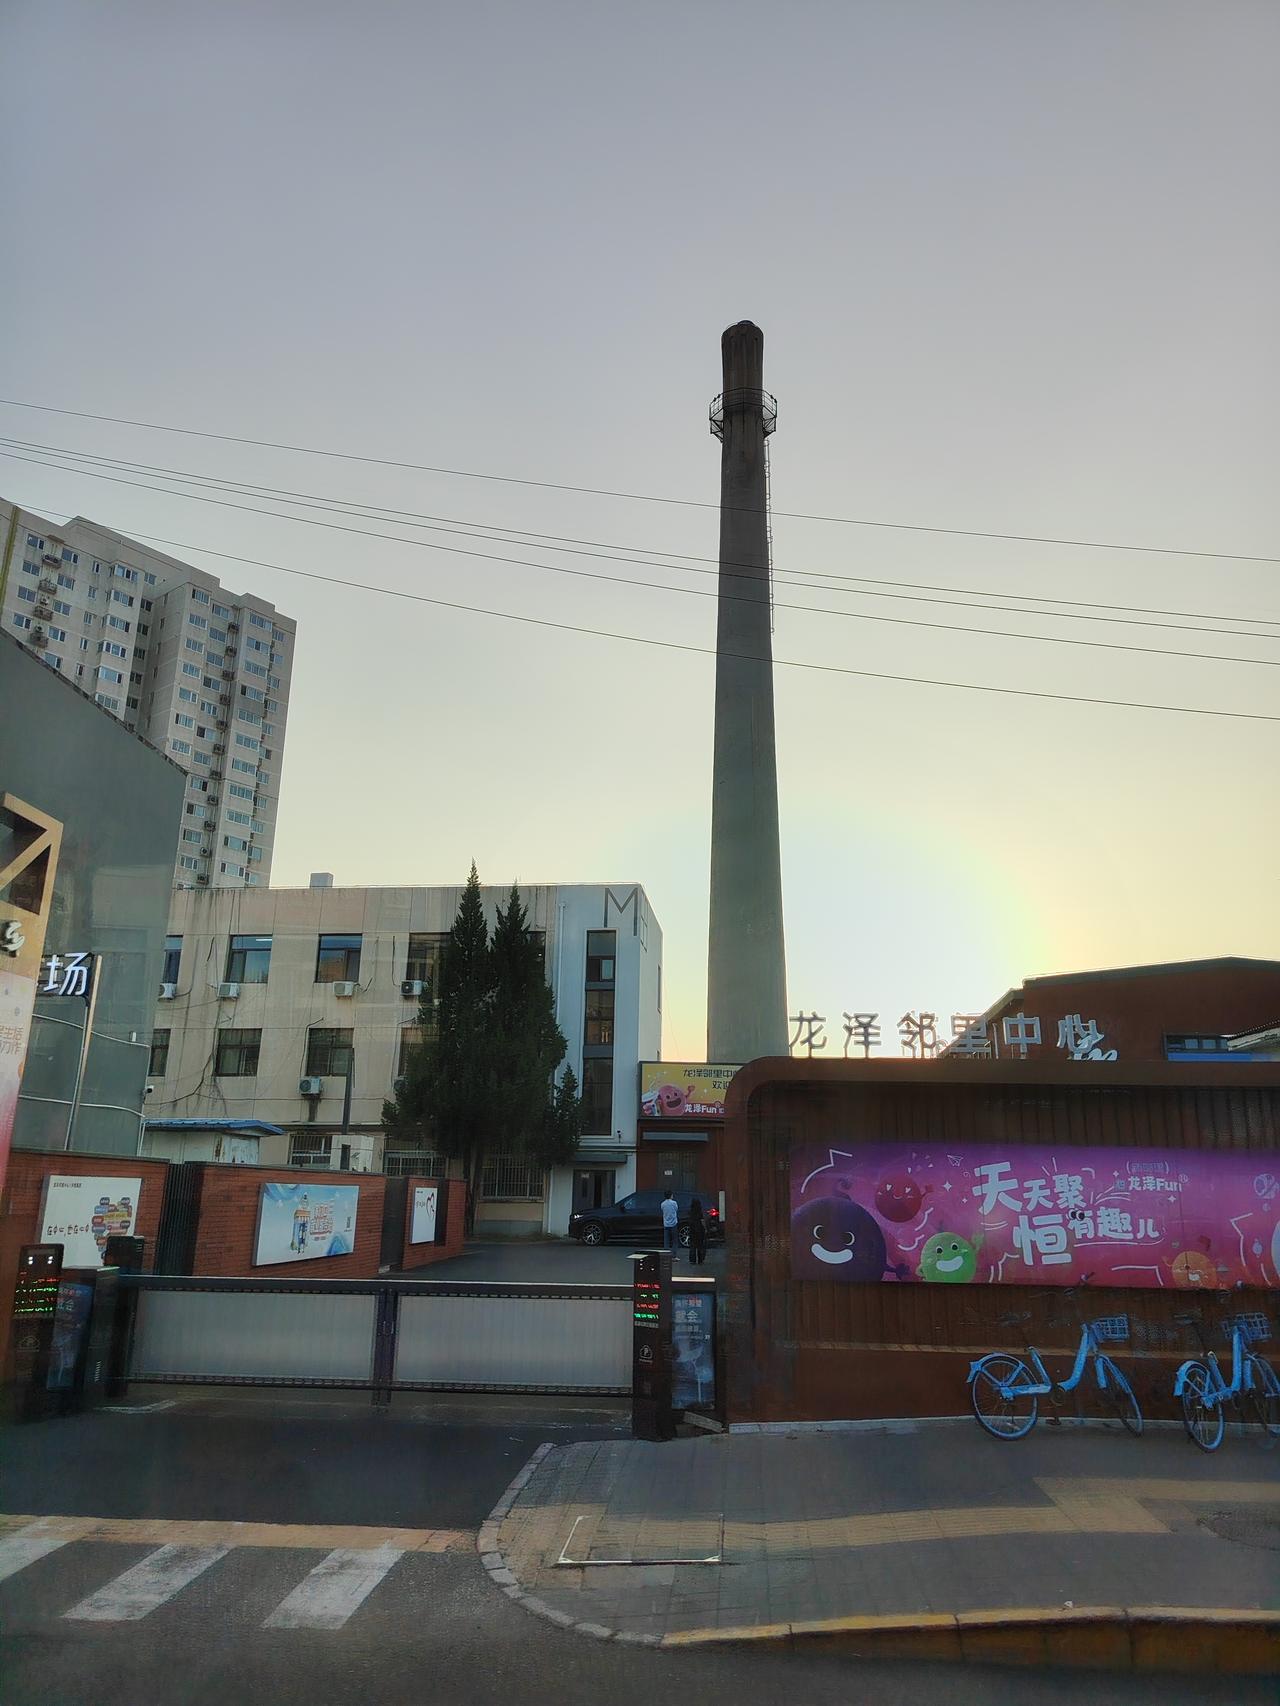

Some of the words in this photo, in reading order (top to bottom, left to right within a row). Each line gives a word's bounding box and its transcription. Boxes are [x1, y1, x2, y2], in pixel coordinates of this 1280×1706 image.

[43, 952, 88, 996] 场
[972, 1161, 1087, 1216] 天天聚
[1012, 1206, 1160, 1266] 恒有趣儿
